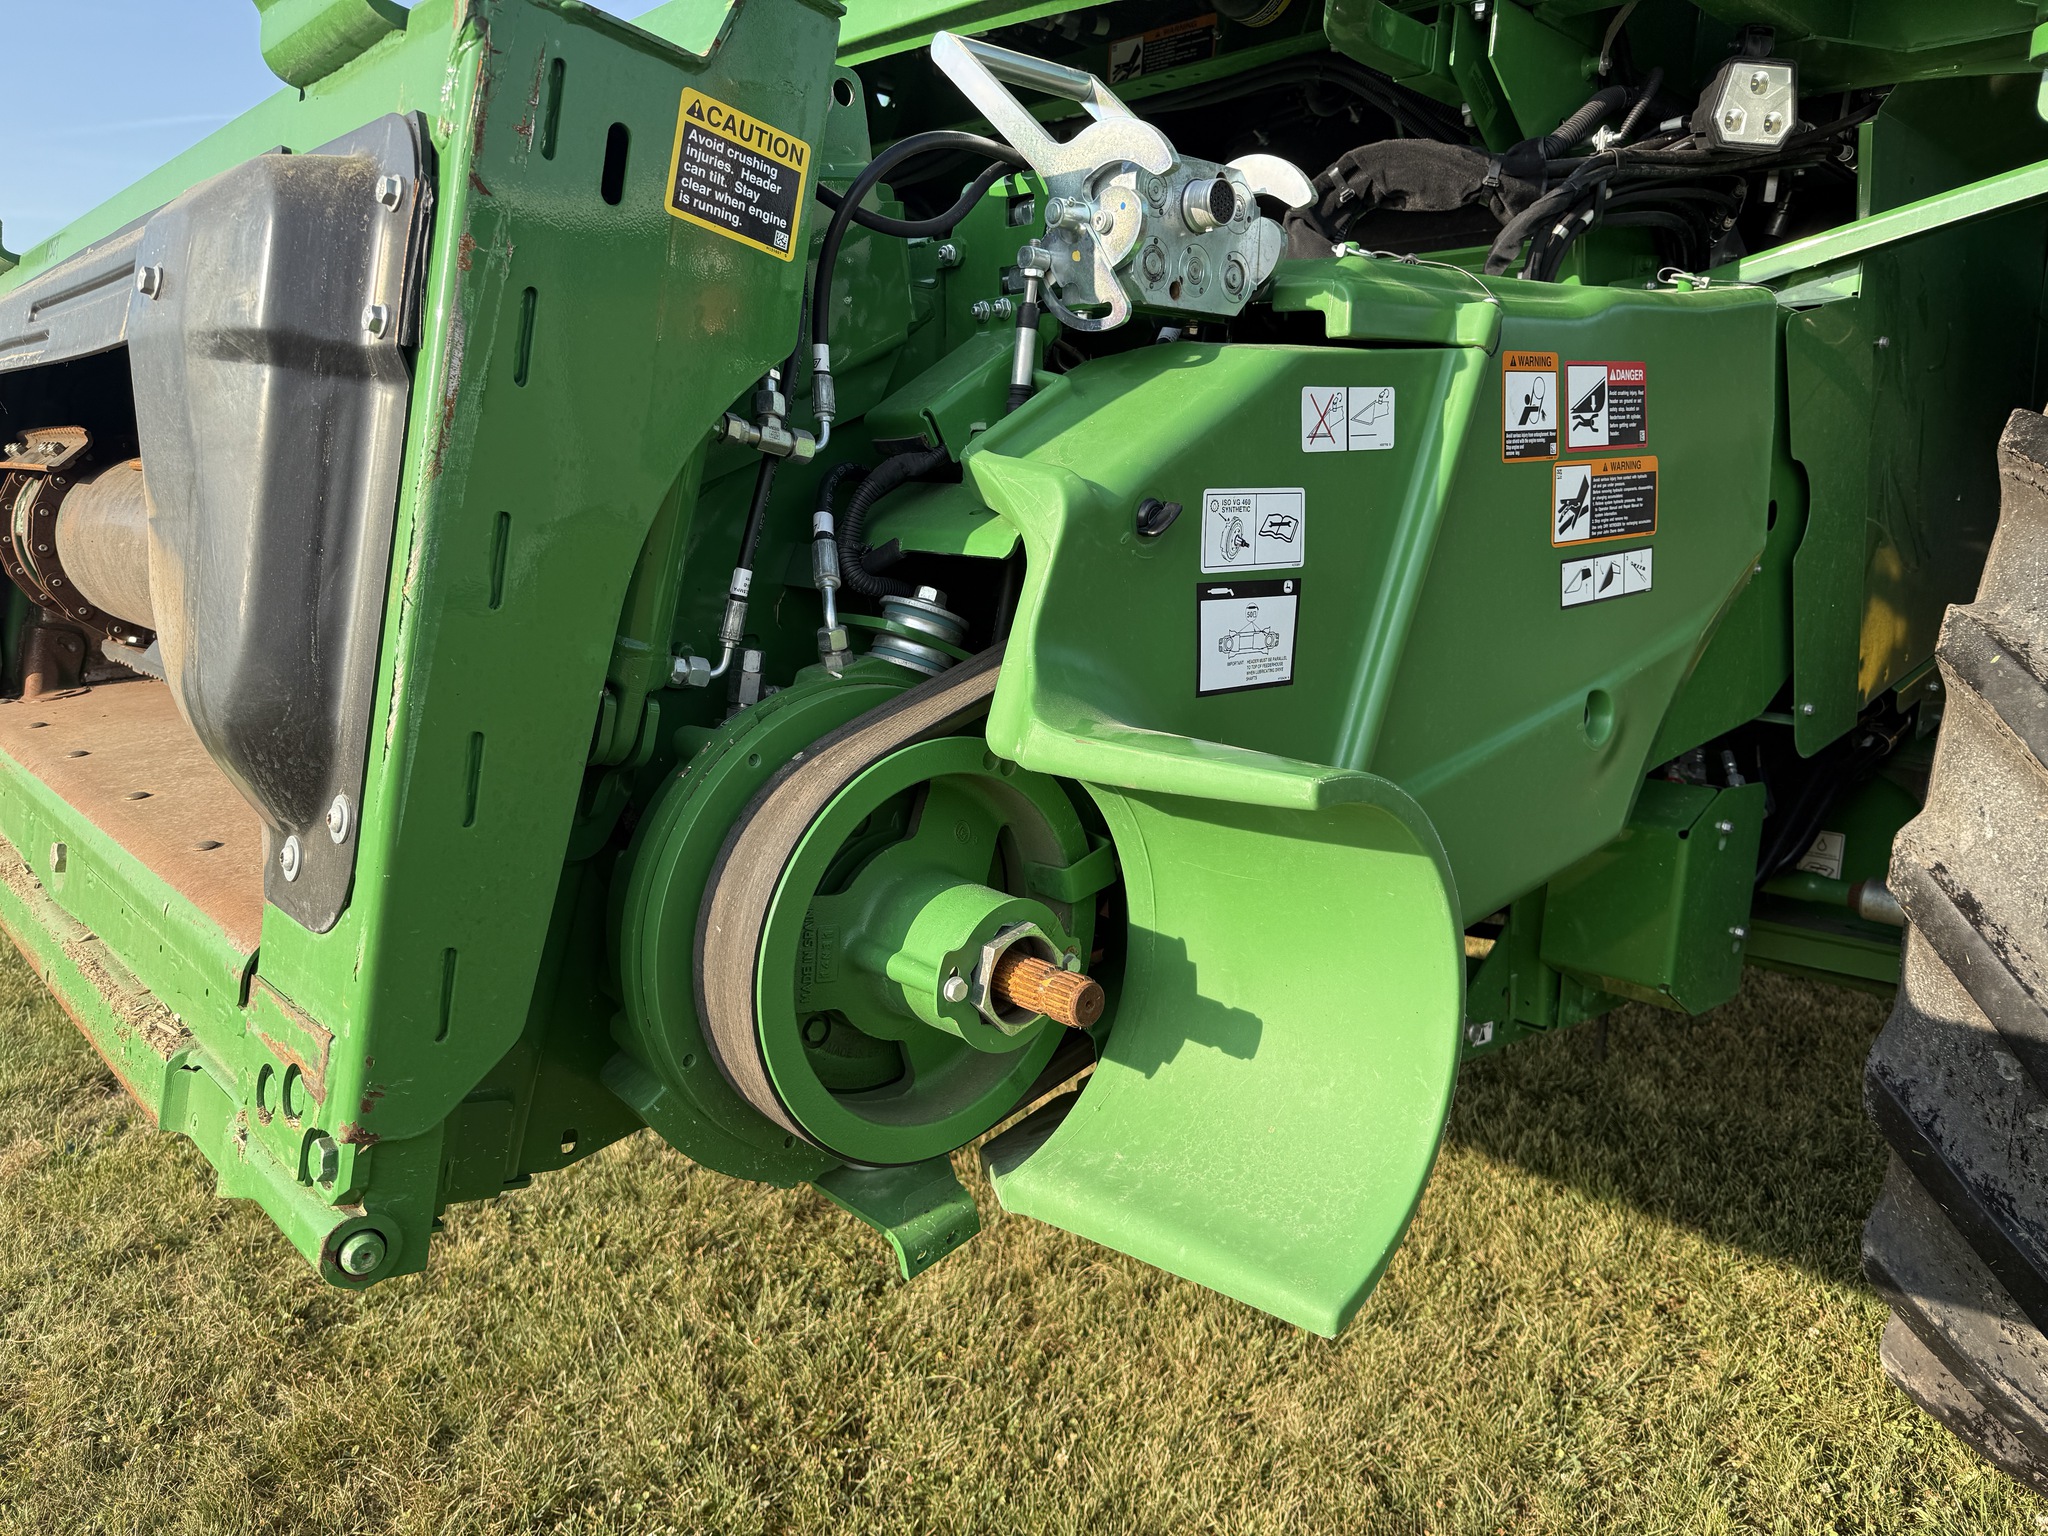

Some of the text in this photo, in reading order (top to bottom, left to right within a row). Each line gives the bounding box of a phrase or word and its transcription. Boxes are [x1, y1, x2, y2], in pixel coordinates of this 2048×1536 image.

[1163, 20, 1197, 34] WARNING
[688, 129, 778, 180] Avoid crushing
[707, 106, 804, 166] CAUTION
[684, 162, 760, 203] can tilt. Stay
[686, 144, 781, 194] injuries. Header
[679, 190, 742, 227] is running.
[681, 177, 787, 228] clear when engine
[1518, 356, 1552, 367] WARNING
[1616, 369, 1643, 380] DANGER
[1610, 460, 1641, 471] WARNING
[800, 908, 814, 1003] MADE IN SPAIN
